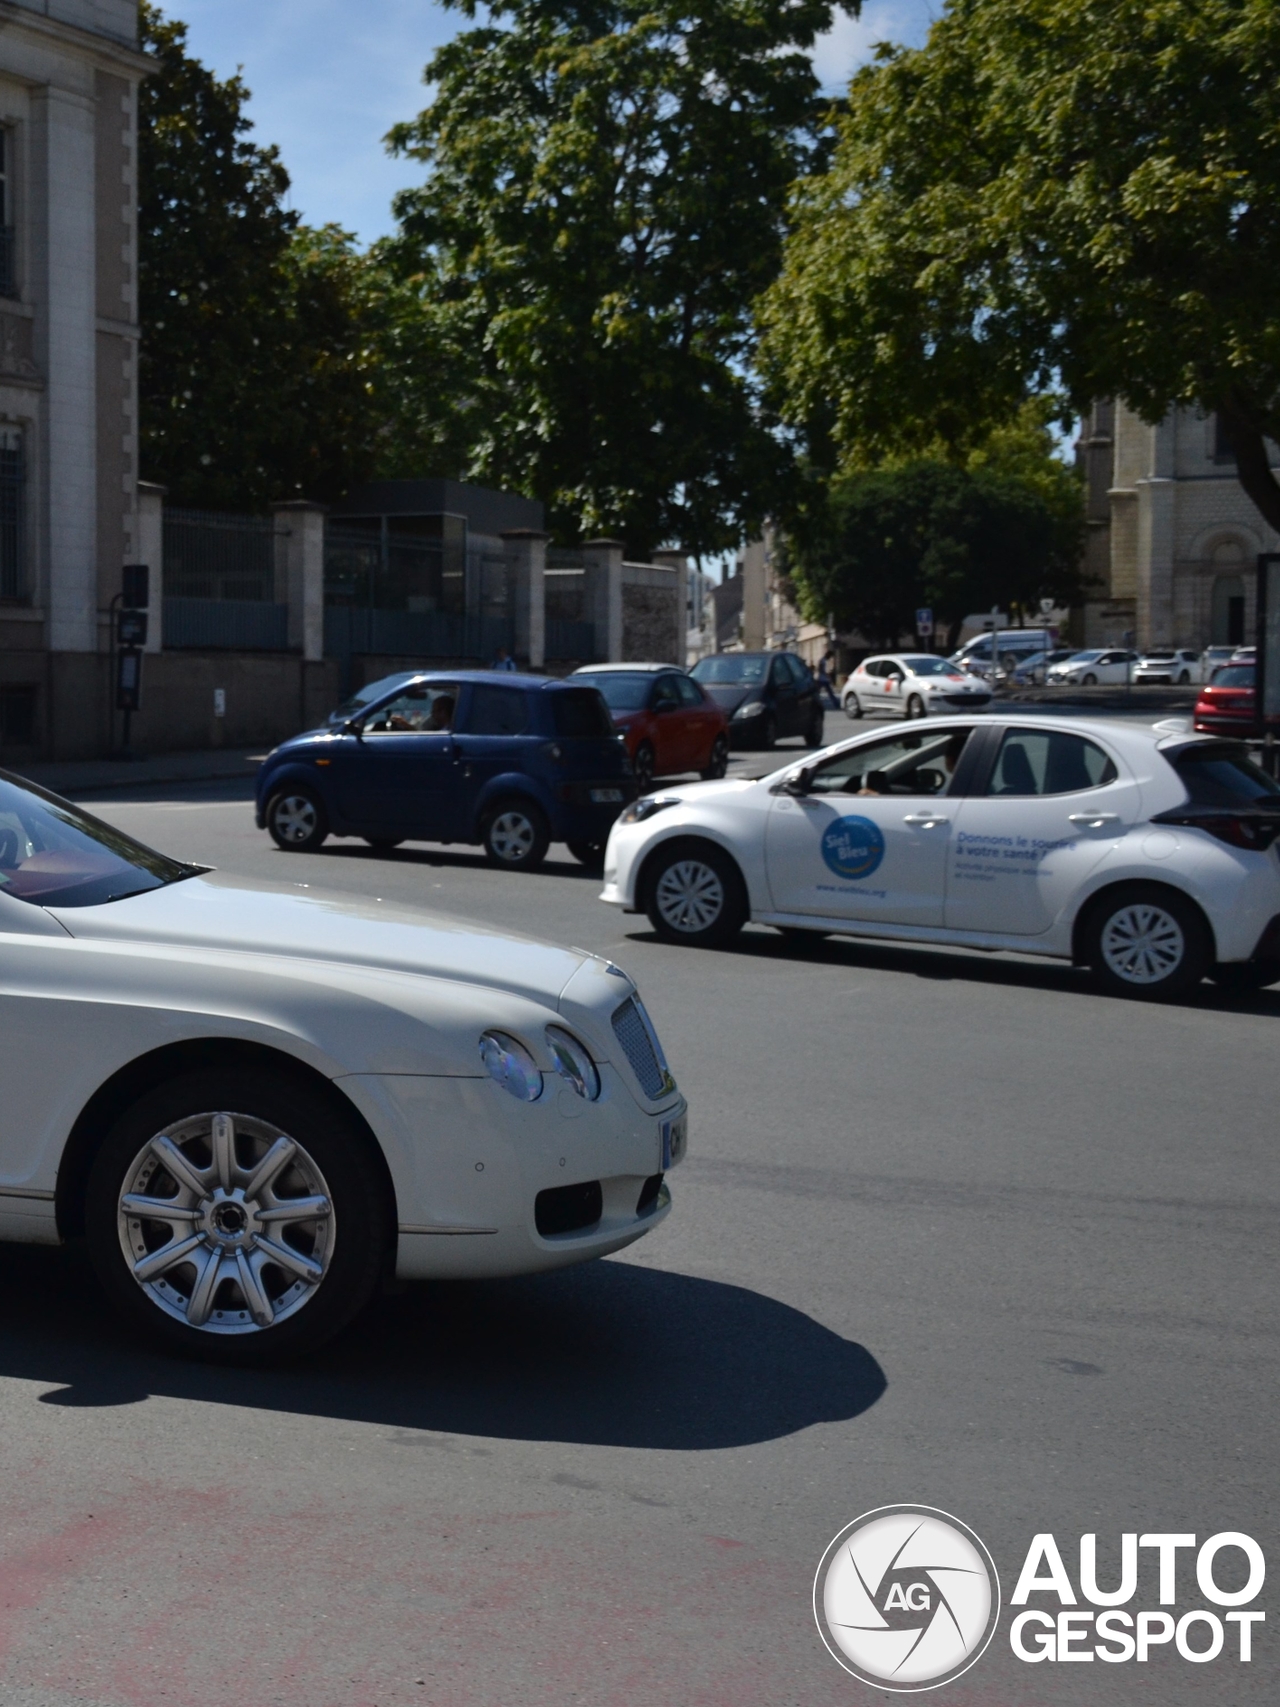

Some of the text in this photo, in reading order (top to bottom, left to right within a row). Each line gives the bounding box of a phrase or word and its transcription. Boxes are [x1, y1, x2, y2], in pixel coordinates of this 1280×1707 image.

[825, 832, 850, 849] Siel
[958, 832, 1077, 851] Donnons le sourire
[837, 845, 869, 860] Bleu
[955, 844, 964, 855] à
[967, 846, 999, 858] votre
[1003, 848, 1039, 860] santé
